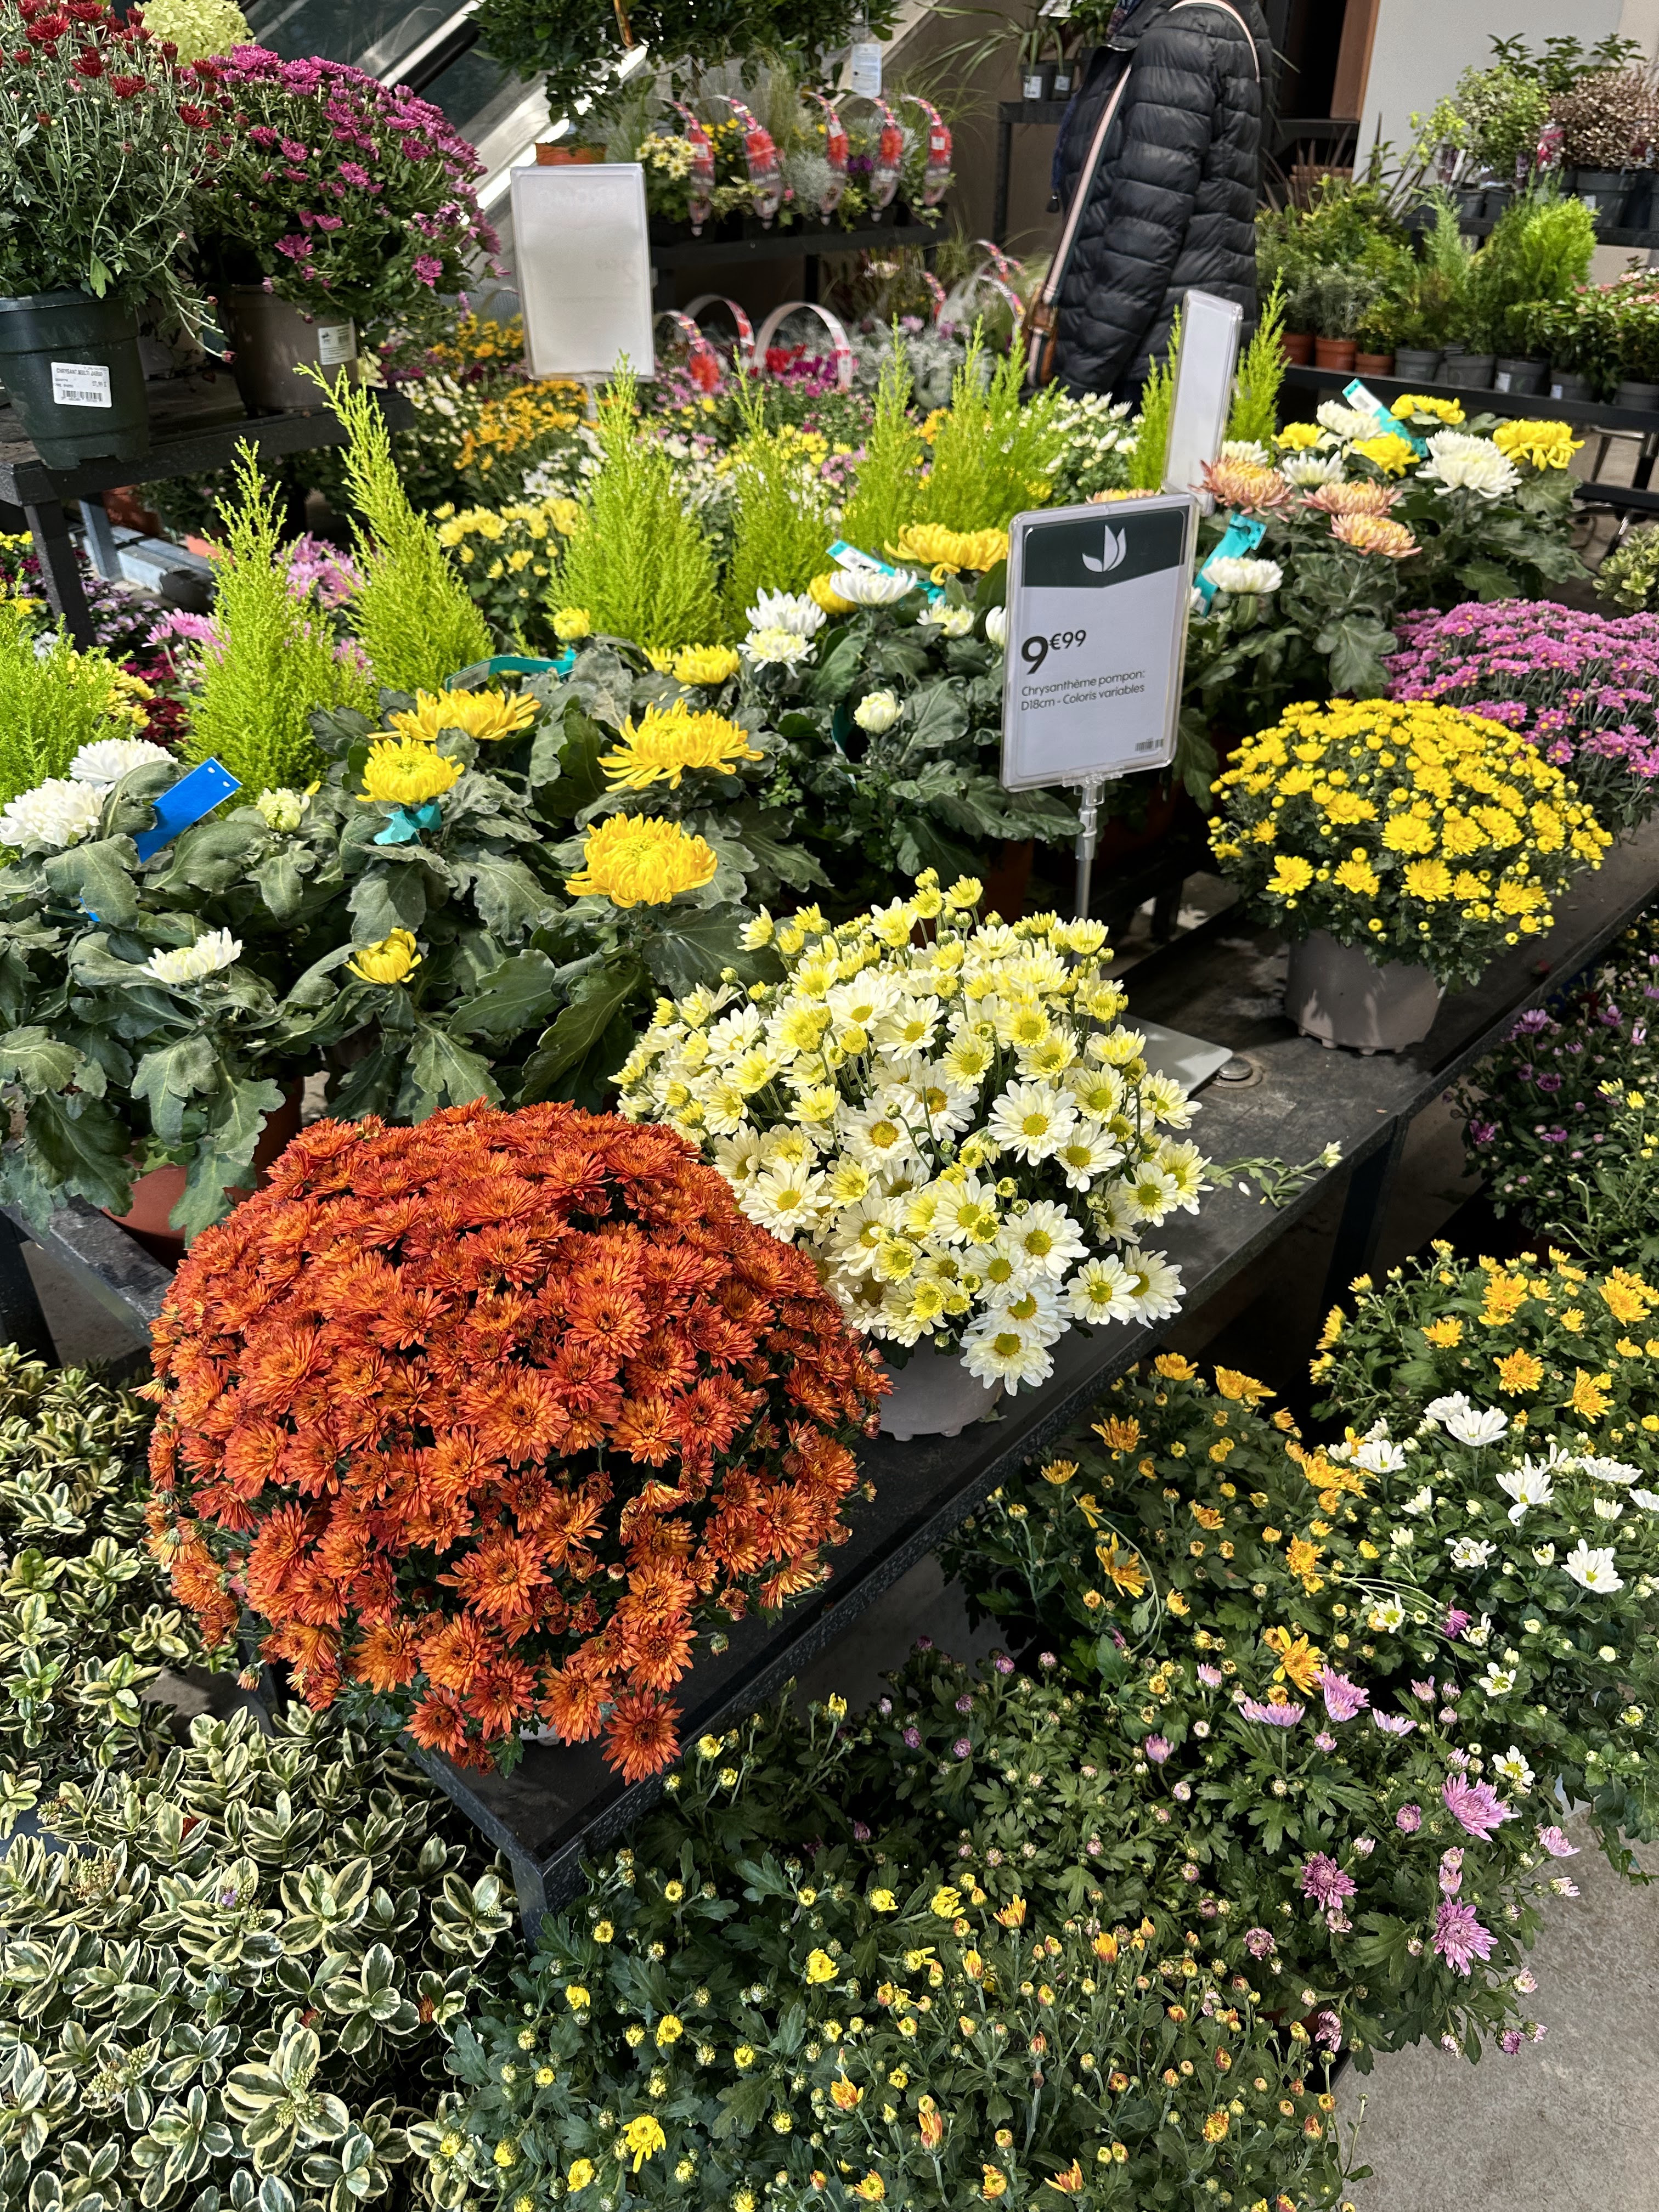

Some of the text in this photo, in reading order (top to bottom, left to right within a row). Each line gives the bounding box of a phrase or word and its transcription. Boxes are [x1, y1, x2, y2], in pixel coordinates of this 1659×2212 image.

[1021, 698, 1054, 710] D18cm
[1063, 691, 1096, 704] Coloris
[1098, 684, 1145, 698] variables
[1022, 679, 1096, 696] Chrysanthème
